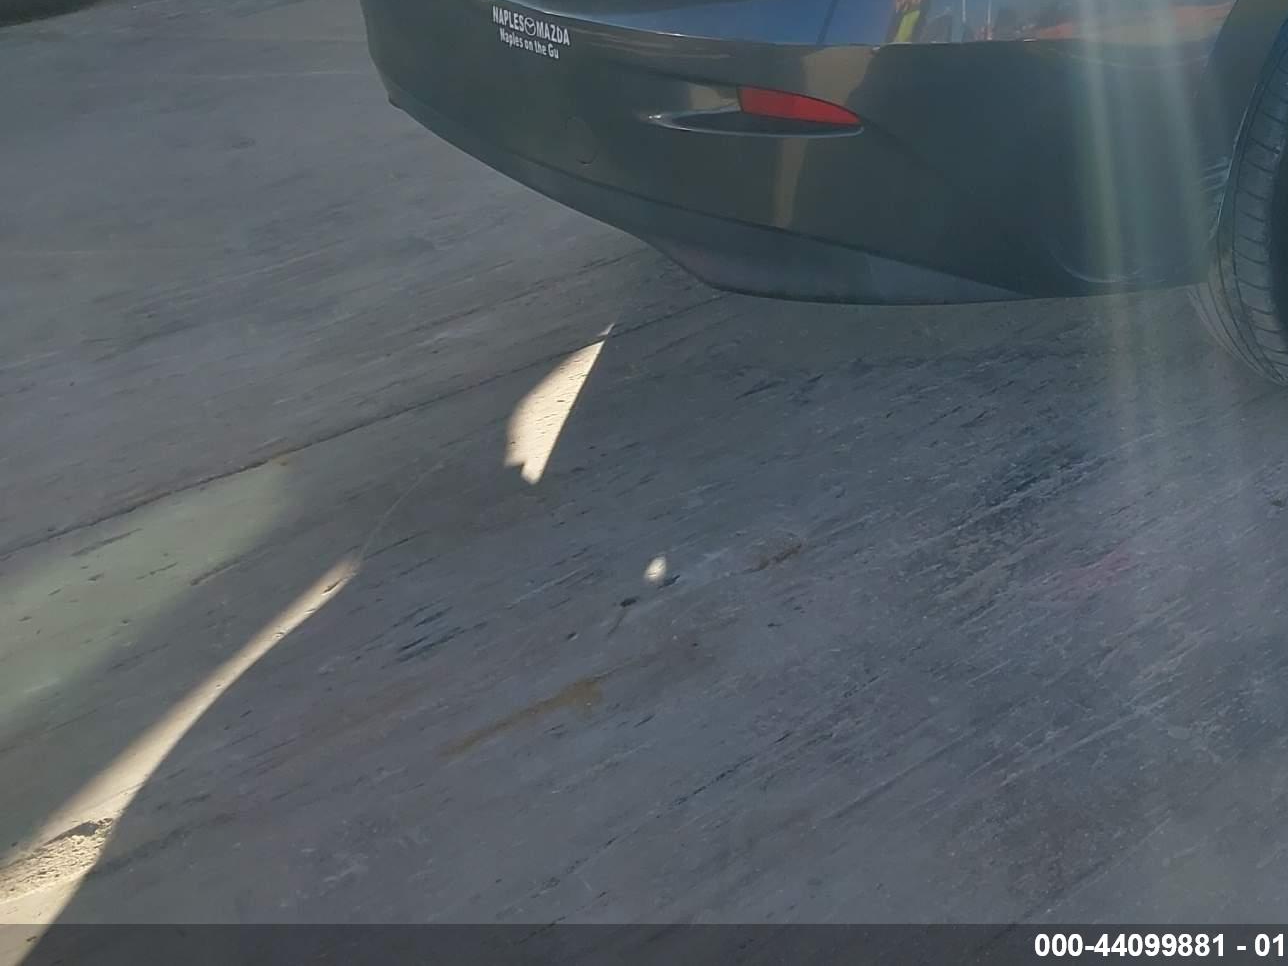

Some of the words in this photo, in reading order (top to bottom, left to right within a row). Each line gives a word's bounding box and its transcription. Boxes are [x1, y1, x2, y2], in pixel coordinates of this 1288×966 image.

[492, 5, 525, 32] NAPLES
[536, 20, 570, 46] MAZDA
[499, 27, 524, 48] Naples
[524, 39, 533, 51] on
[534, 40, 547, 56] the
